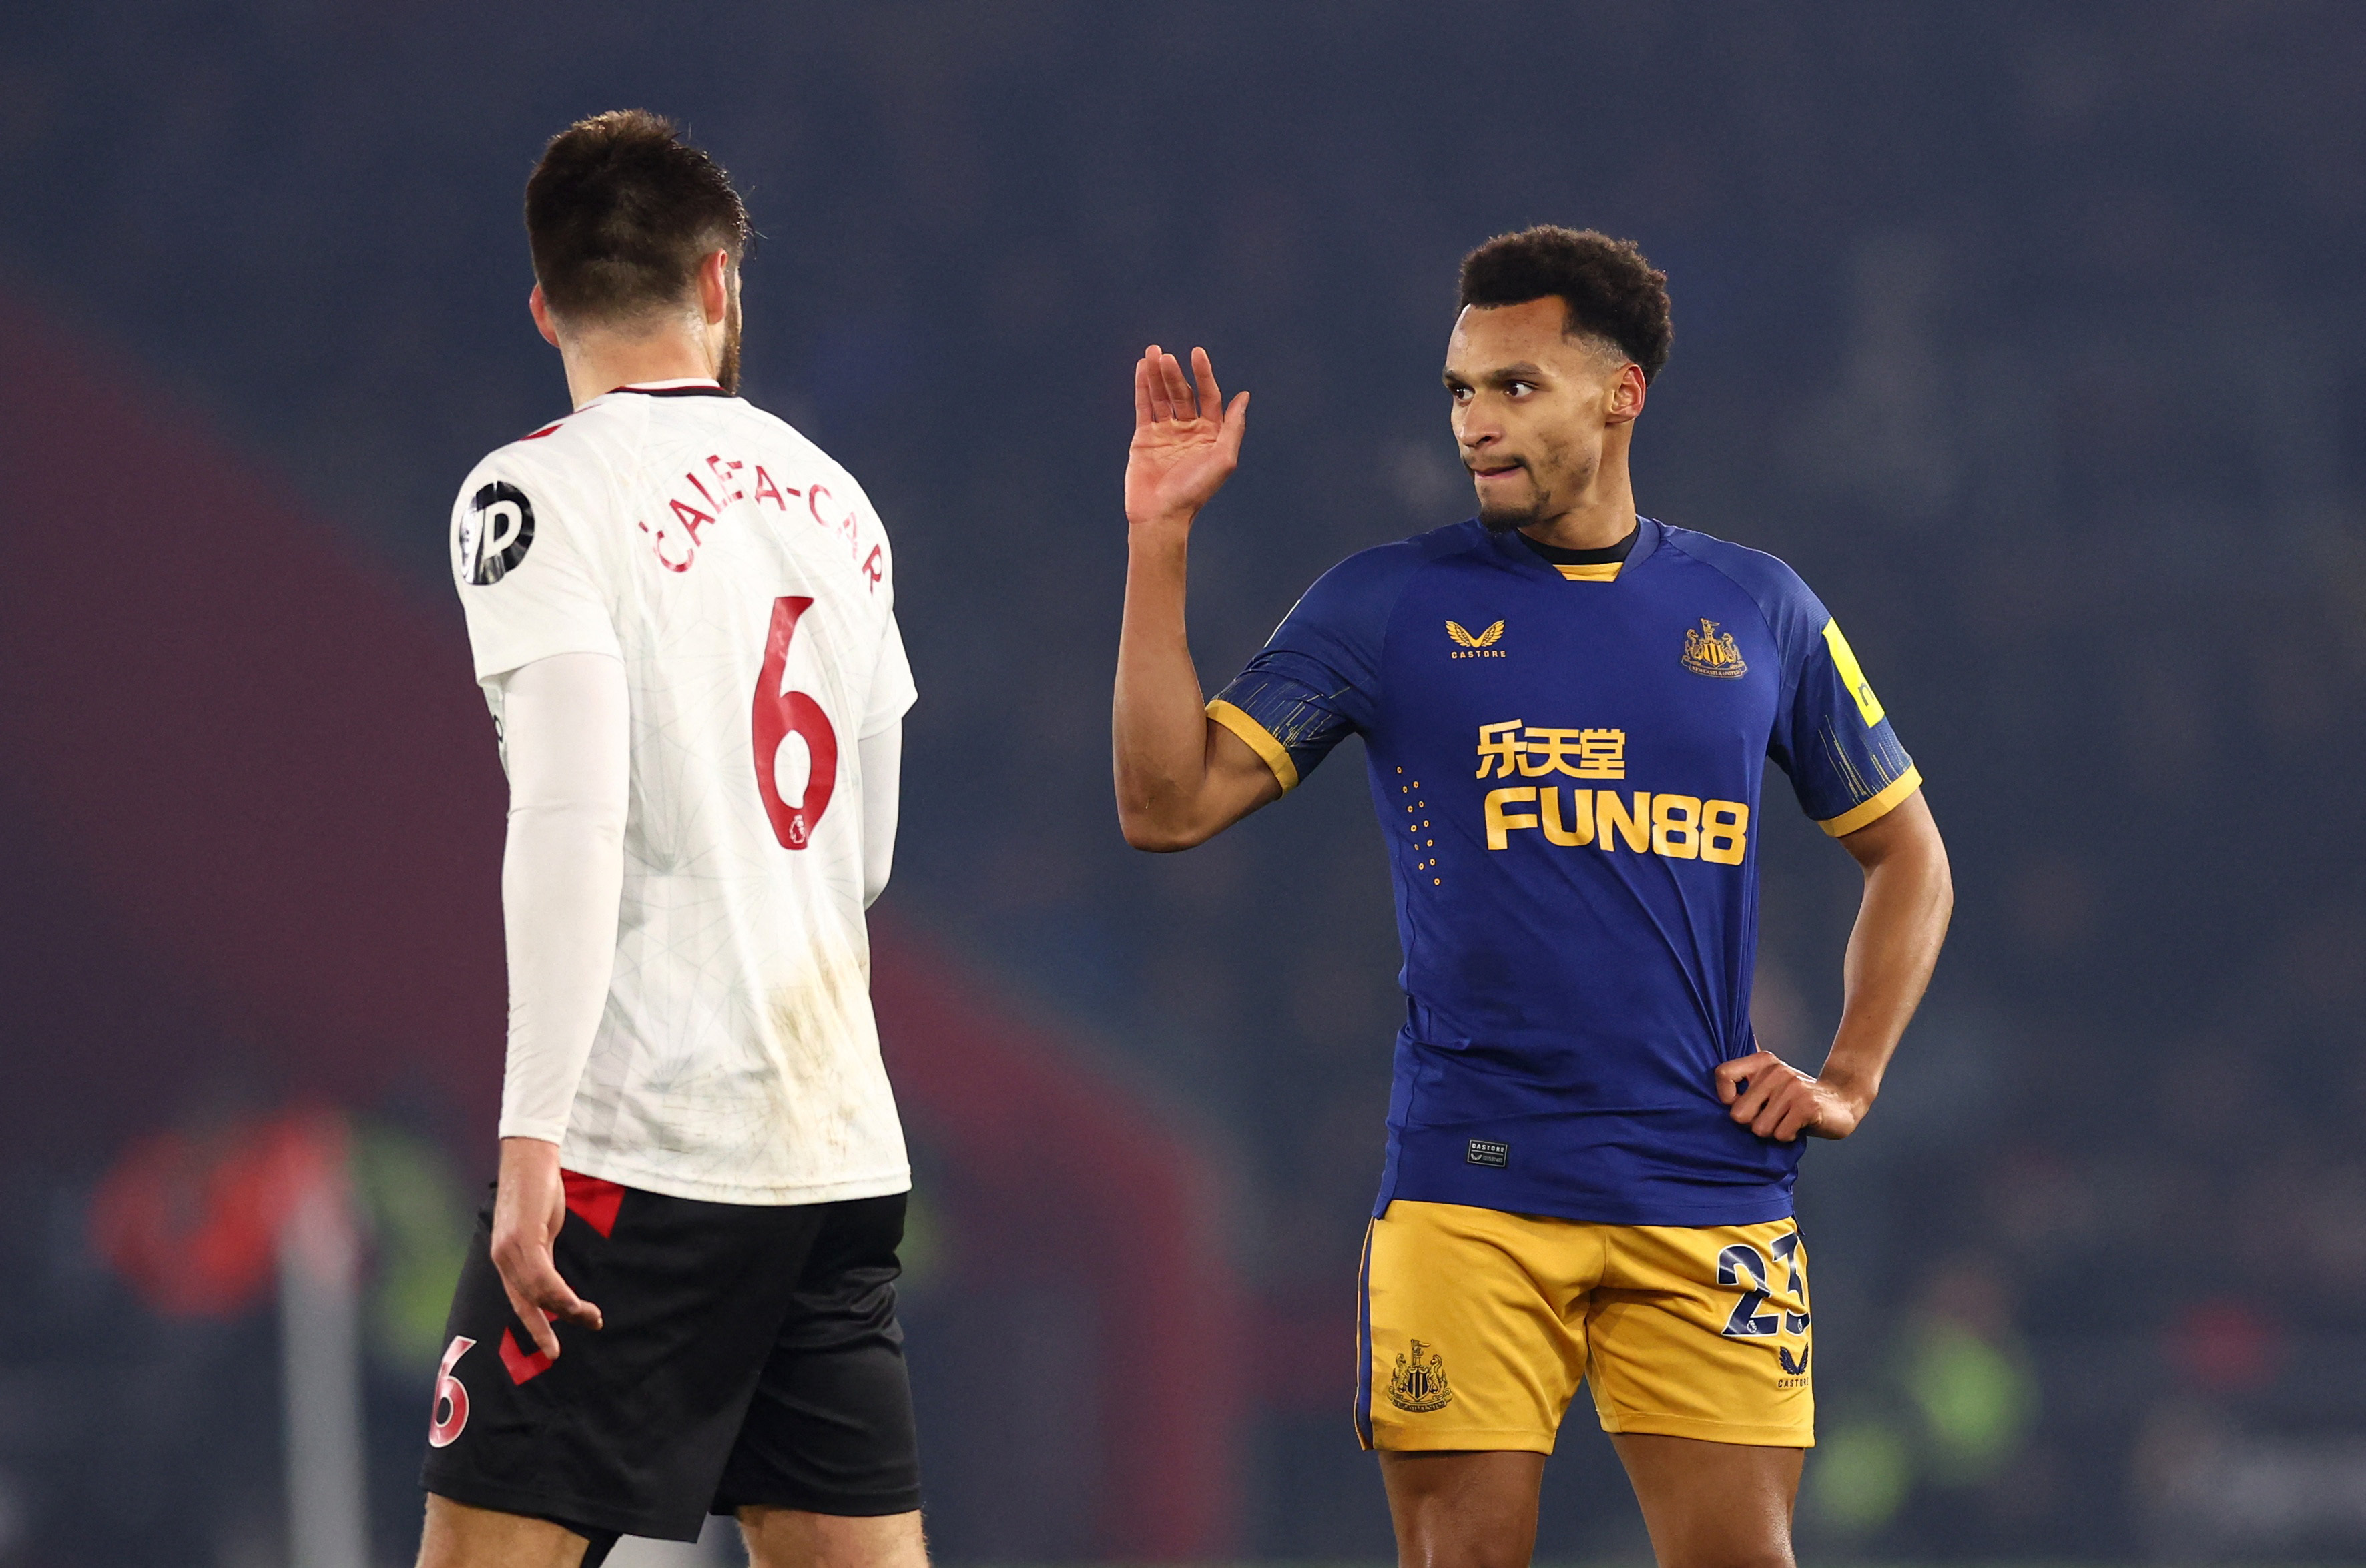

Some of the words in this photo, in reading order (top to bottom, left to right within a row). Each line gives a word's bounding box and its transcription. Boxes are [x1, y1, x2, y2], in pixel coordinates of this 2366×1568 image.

[1451, 650, 1506, 659] CASTORE
[752, 596, 838, 850] 6
[1476, 719, 1626, 779] 乐天堂
[1484, 786, 1749, 866] FUN88
[1472, 1143, 1504, 1153] CASTORE
[428, 1335, 477, 1448] 6
